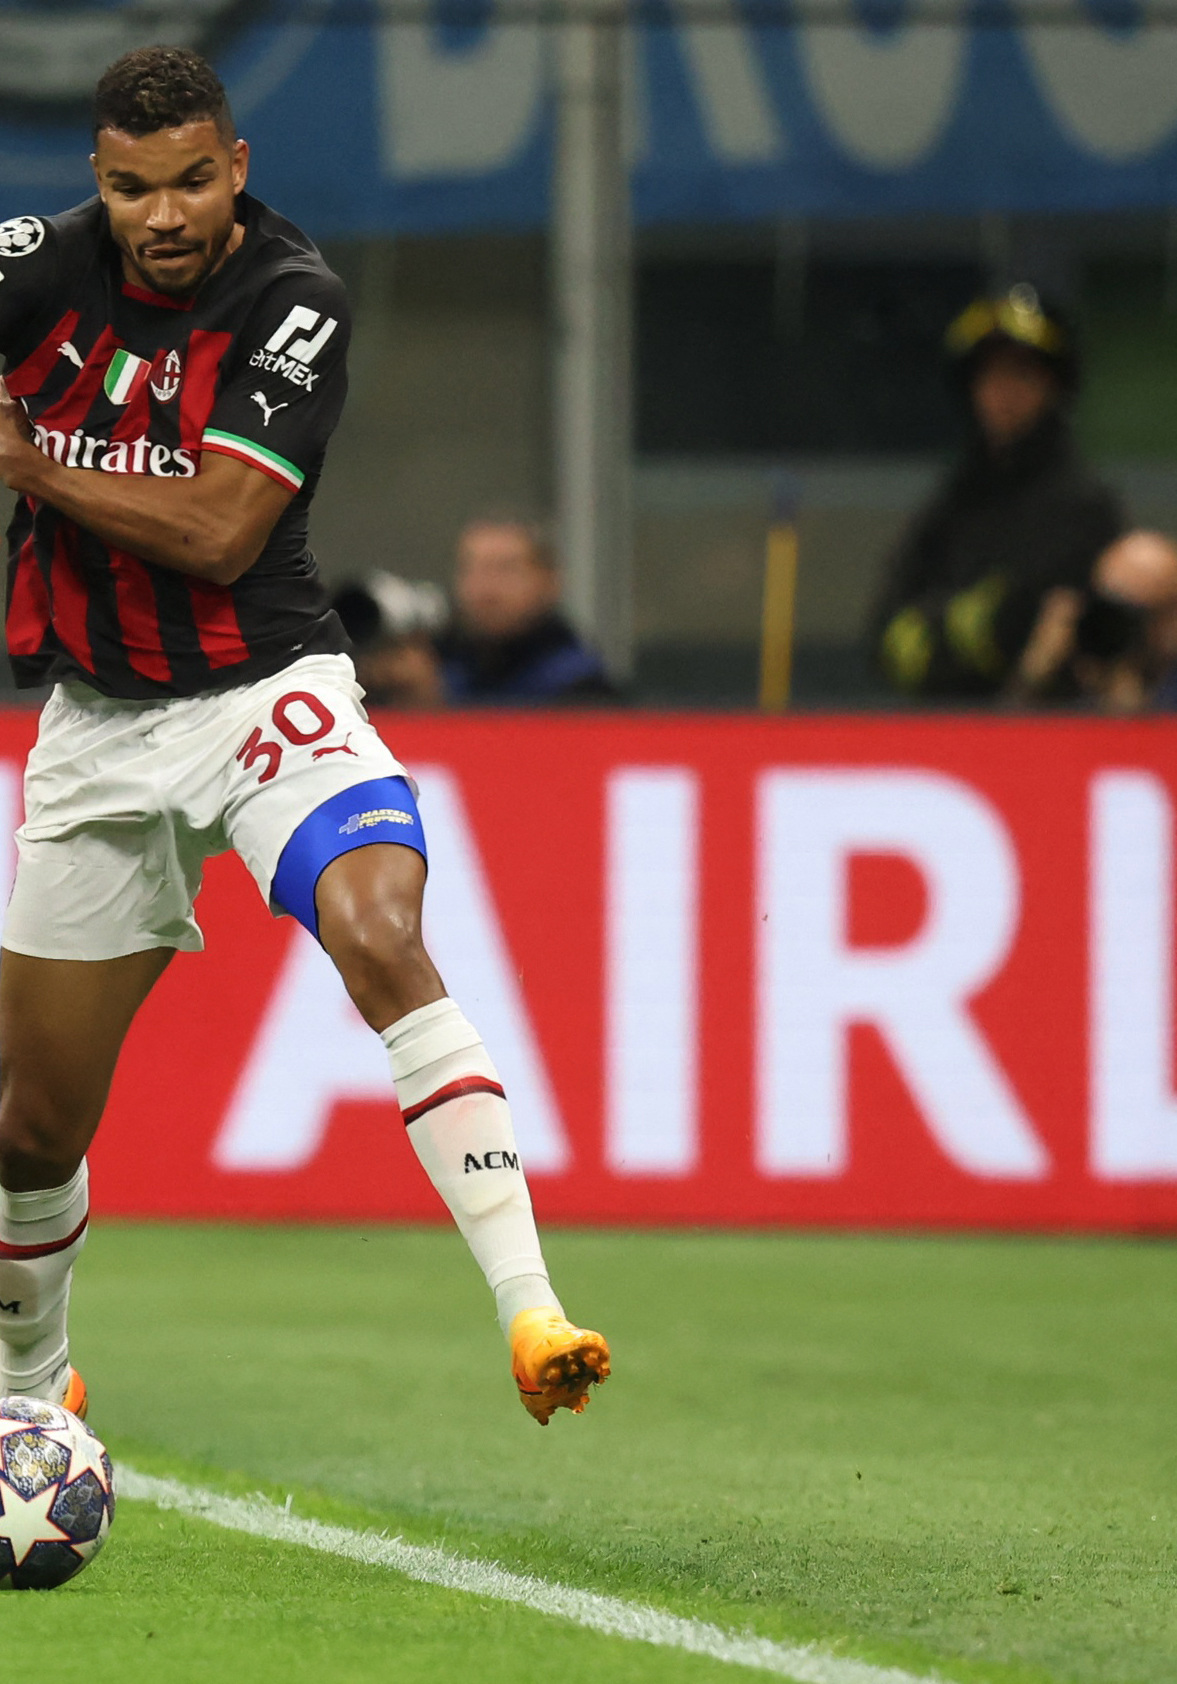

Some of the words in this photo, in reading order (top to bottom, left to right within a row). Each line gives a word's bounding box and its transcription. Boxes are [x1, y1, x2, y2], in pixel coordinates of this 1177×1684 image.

[249, 349, 320, 392] BitMEX
[27, 424, 196, 478] mirates
[236, 691, 335, 785] 30
[464, 1151, 519, 1174] ACM
